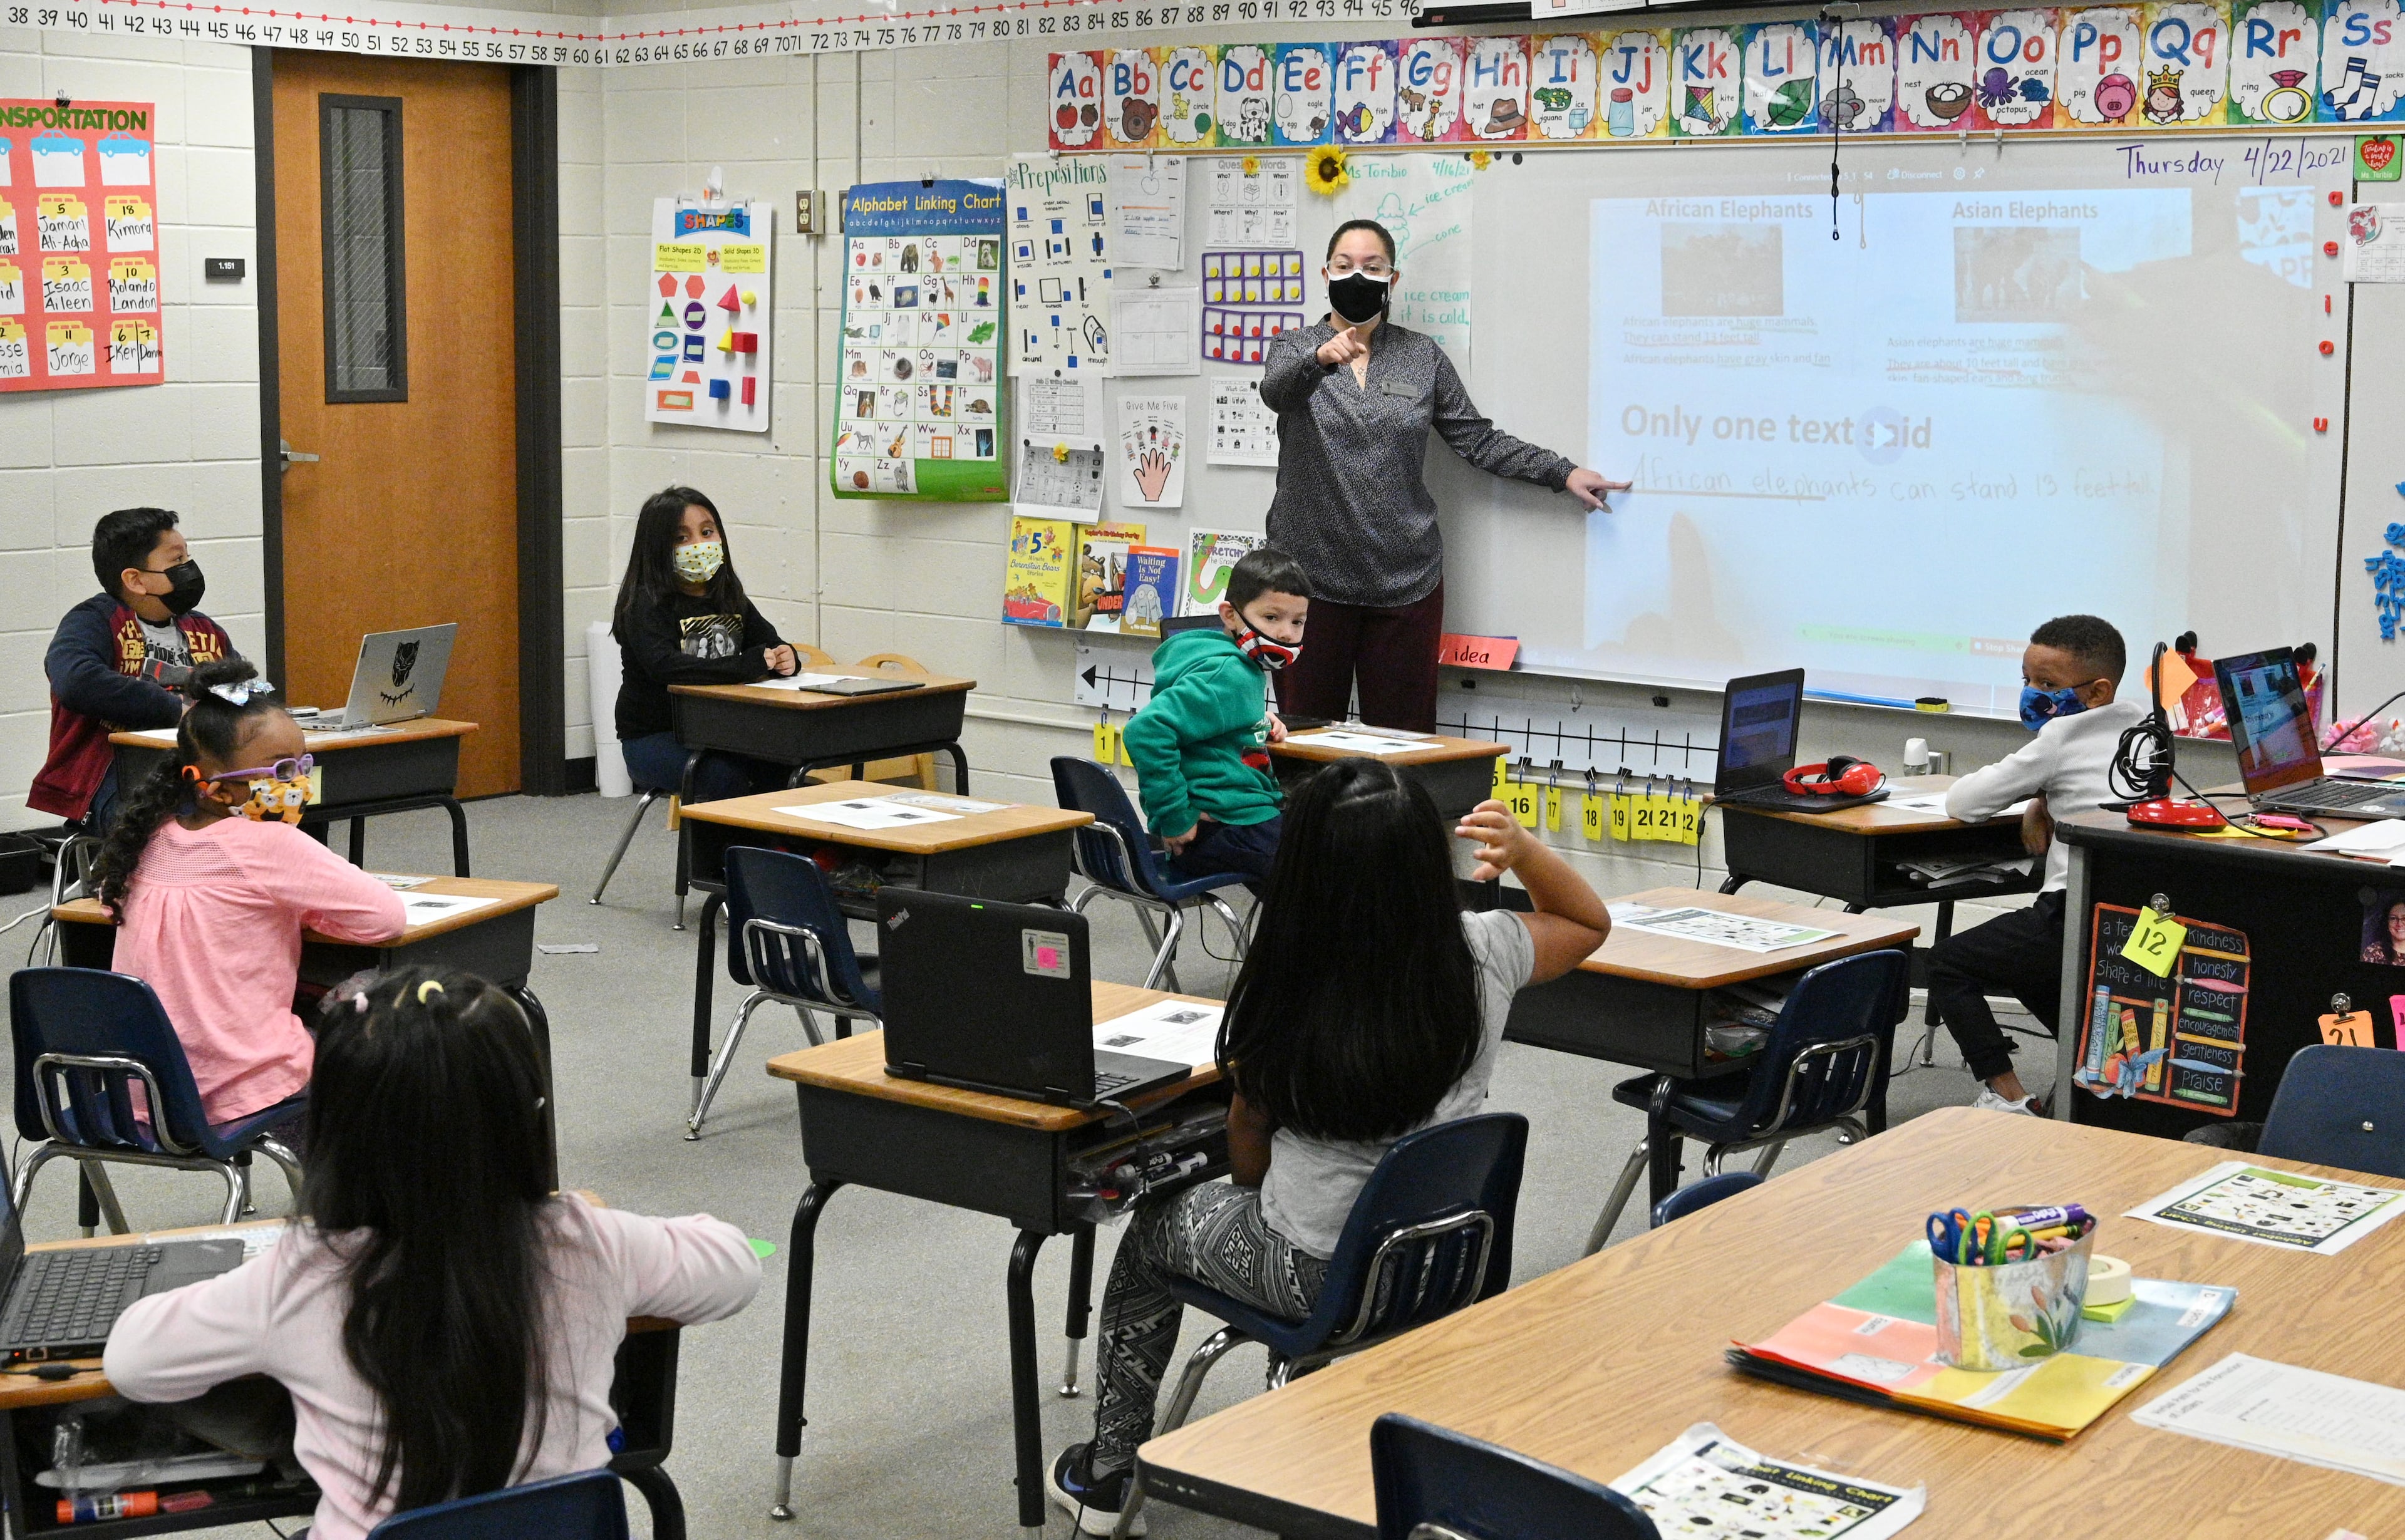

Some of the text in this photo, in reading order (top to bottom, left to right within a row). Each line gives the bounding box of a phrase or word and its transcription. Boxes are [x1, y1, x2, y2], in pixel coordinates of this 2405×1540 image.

[8, 7, 173, 34] 38 39 40 41 42 43
[1111, 5, 1204, 28] 85 86 87 88
[2342, 12, 2392, 46] Ss
[1987, 24, 2045, 64] Oo
[2151, 18, 2216, 69] Qq
[2247, 18, 2300, 58] Rr
[1828, 34, 1885, 67] Mm
[1911, 30, 1959, 64] Nn
[2073, 23, 2122, 76] Pp
[1549, 49, 1577, 83] Ii
[1682, 41, 1727, 81] Kk
[1170, 59, 1204, 91] Cc
[1224, 58, 1265, 92] Dd
[1285, 56, 1321, 92] Ee
[1347, 54, 1384, 91] Ff
[1409, 51, 1452, 96] Gg
[1474, 52, 1520, 88] Hh
[1613, 46, 1650, 94] Jj
[2025, 68, 2049, 76] ocean
[1057, 68, 1094, 98] Aa
[1114, 63, 1150, 96] Bb
[1905, 80, 1921, 88] nest
[2074, 88, 2086, 98] pig
[2190, 88, 2215, 98] queen
[2242, 83, 2259, 93] ring
[1720, 94, 1734, 102] kite
[1641, 105, 1653, 115] jar
[1997, 106, 2028, 115] octopus
[1226, 120, 1236, 128] dog
[1260, 160, 1286, 169] Words
[2116, 138, 2346, 185] Thursday 4/22/2021
[1018, 158, 1106, 197] Prepositions
[1363, 163, 1407, 178] Toribio
[1901, 170, 1942, 180] Disconnect
[851, 194, 1001, 215] Alphabet Linking Chart
[1425, 192, 1442, 204] ice
[2329, 191, 2343, 205] a
[57, 204, 65, 214] 5
[122, 205, 135, 215] 18
[1646, 199, 1813, 220] African Elephants
[1953, 202, 2099, 222] Asian Elephants
[684, 214, 743, 229] SHAPES
[1435, 224, 1462, 241] cone
[852, 239, 864, 249] Aa
[889, 239, 899, 249] Bb
[964, 237, 976, 247] Dd
[2323, 240, 2338, 256] e
[61, 266, 69, 276] 3
[126, 268, 137, 278] 10
[218, 262, 235, 270] 1.151
[43, 281, 90, 297] Isaac
[108, 279, 155, 295] Rolando
[1405, 288, 1469, 302] ice cream
[45, 297, 91, 311] Aileen
[112, 297, 156, 311] Landon
[2325, 294, 2331, 313] i
[1402, 304, 1469, 325] it is cold.
[118, 329, 127, 341] 6
[140, 329, 150, 340] 7
[2319, 340, 2334, 354] o
[50, 348, 89, 373] Jorge
[1088, 358, 1107, 366] through
[1126, 401, 1178, 411] Give Me Five
[1621, 405, 1932, 449] Only one text said
[2314, 417, 2328, 432] u
[1632, 452, 1732, 490] African
[1753, 467, 1877, 506] elephants
[1890, 483, 1937, 501] can
[2036, 474, 2057, 497] 13
[1010, 559, 1060, 571] Berenstain Bears
[1137, 556, 1166, 568] Waiting
[1148, 566, 1162, 574] Not
[1139, 574, 1161, 584] Easy!
[1097, 595, 1123, 610] UNDER
[1454, 646, 1489, 665] idea
[1100, 735, 1105, 750] 1
[1511, 797, 1529, 814] 16
[1548, 802, 1556, 818] 17
[1586, 809, 1596, 826] 18
[1613, 810, 1624, 826] 19
[1659, 810, 1677, 827] 21
[2138, 928, 2166, 956] 12
[2188, 929, 2242, 953] Kindness
[2194, 957, 2237, 978] honesty
[2189, 990, 2237, 1011] respect
[2179, 1018, 2240, 1040] encouragement
[2182, 1043, 2232, 1064] gentleness
